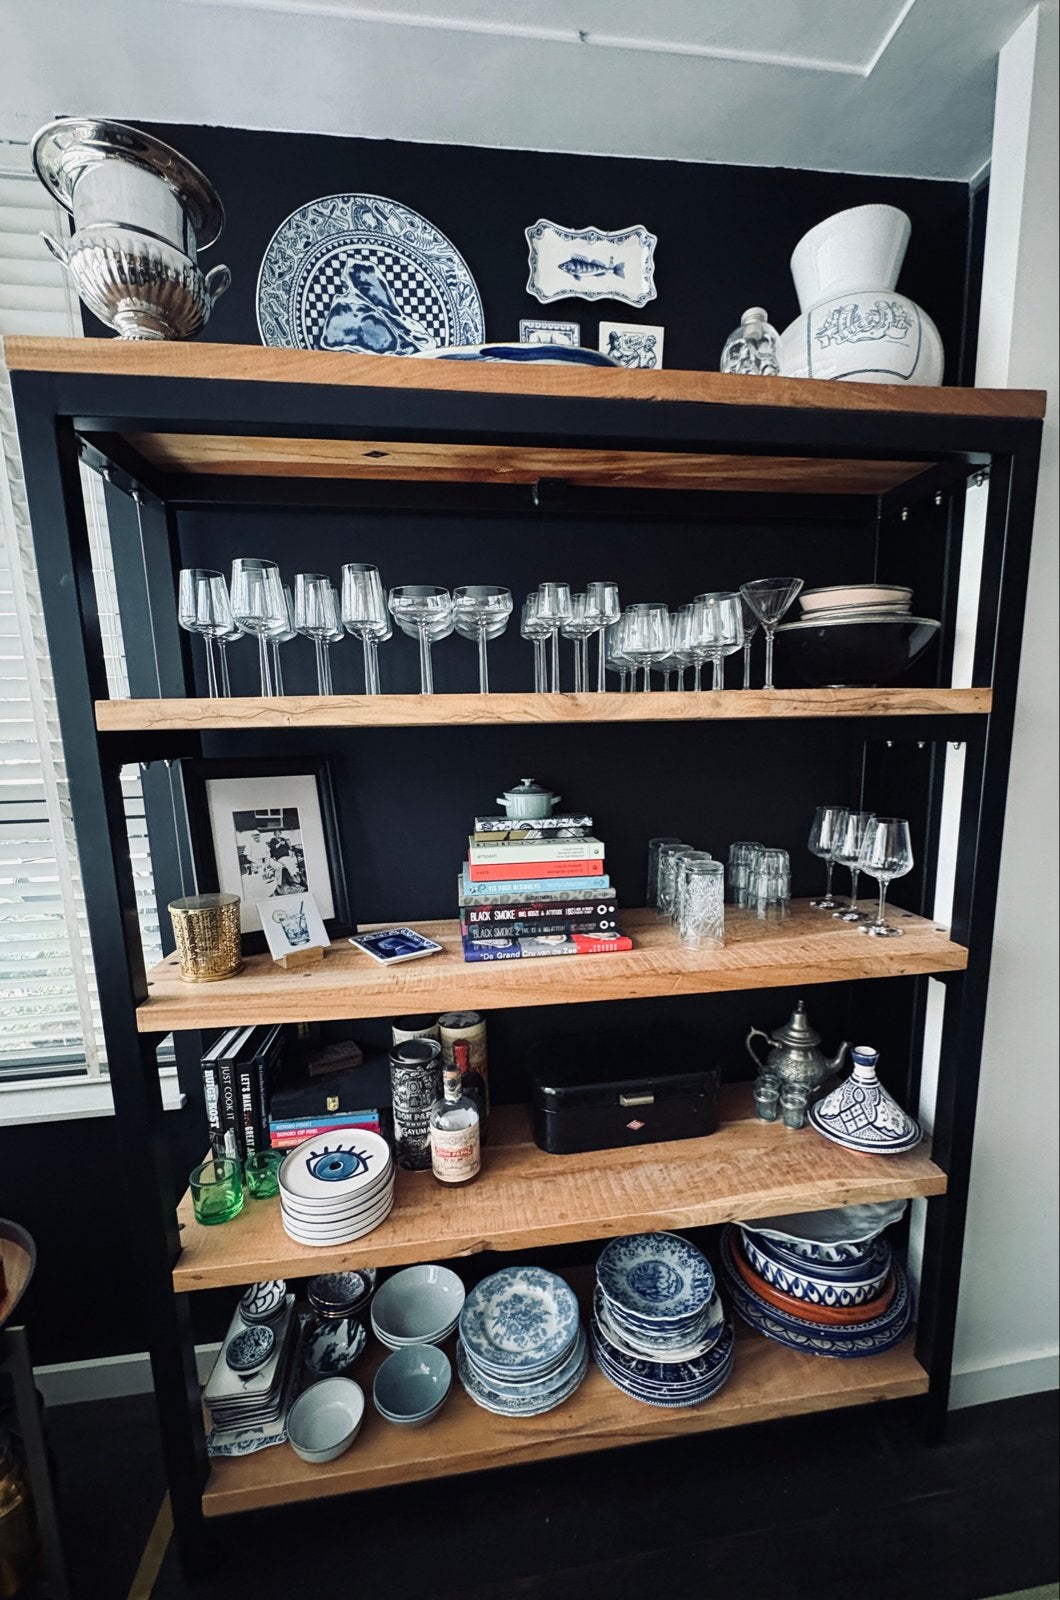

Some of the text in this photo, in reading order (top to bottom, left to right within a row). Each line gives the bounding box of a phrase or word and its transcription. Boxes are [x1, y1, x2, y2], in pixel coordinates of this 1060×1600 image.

[470, 911, 491, 922] BLACK
[494, 909, 516, 920] SMOKE
[473, 928, 493, 939] BLACK
[493, 926, 514, 937] SMOKE
[515, 928, 521, 936] 2
[496, 951, 521, 959] Grand
[220, 1065, 231, 1084] JUST
[240, 1073, 251, 1093] LET'S
[224, 1086, 234, 1111] COOK
[242, 1093, 252, 1112] MAKE
[207, 1101, 220, 1129] KOST
[226, 1112, 235, 1121] IT
[397, 1111, 432, 1121] DON PAP
[245, 1126, 255, 1146] GREAT
